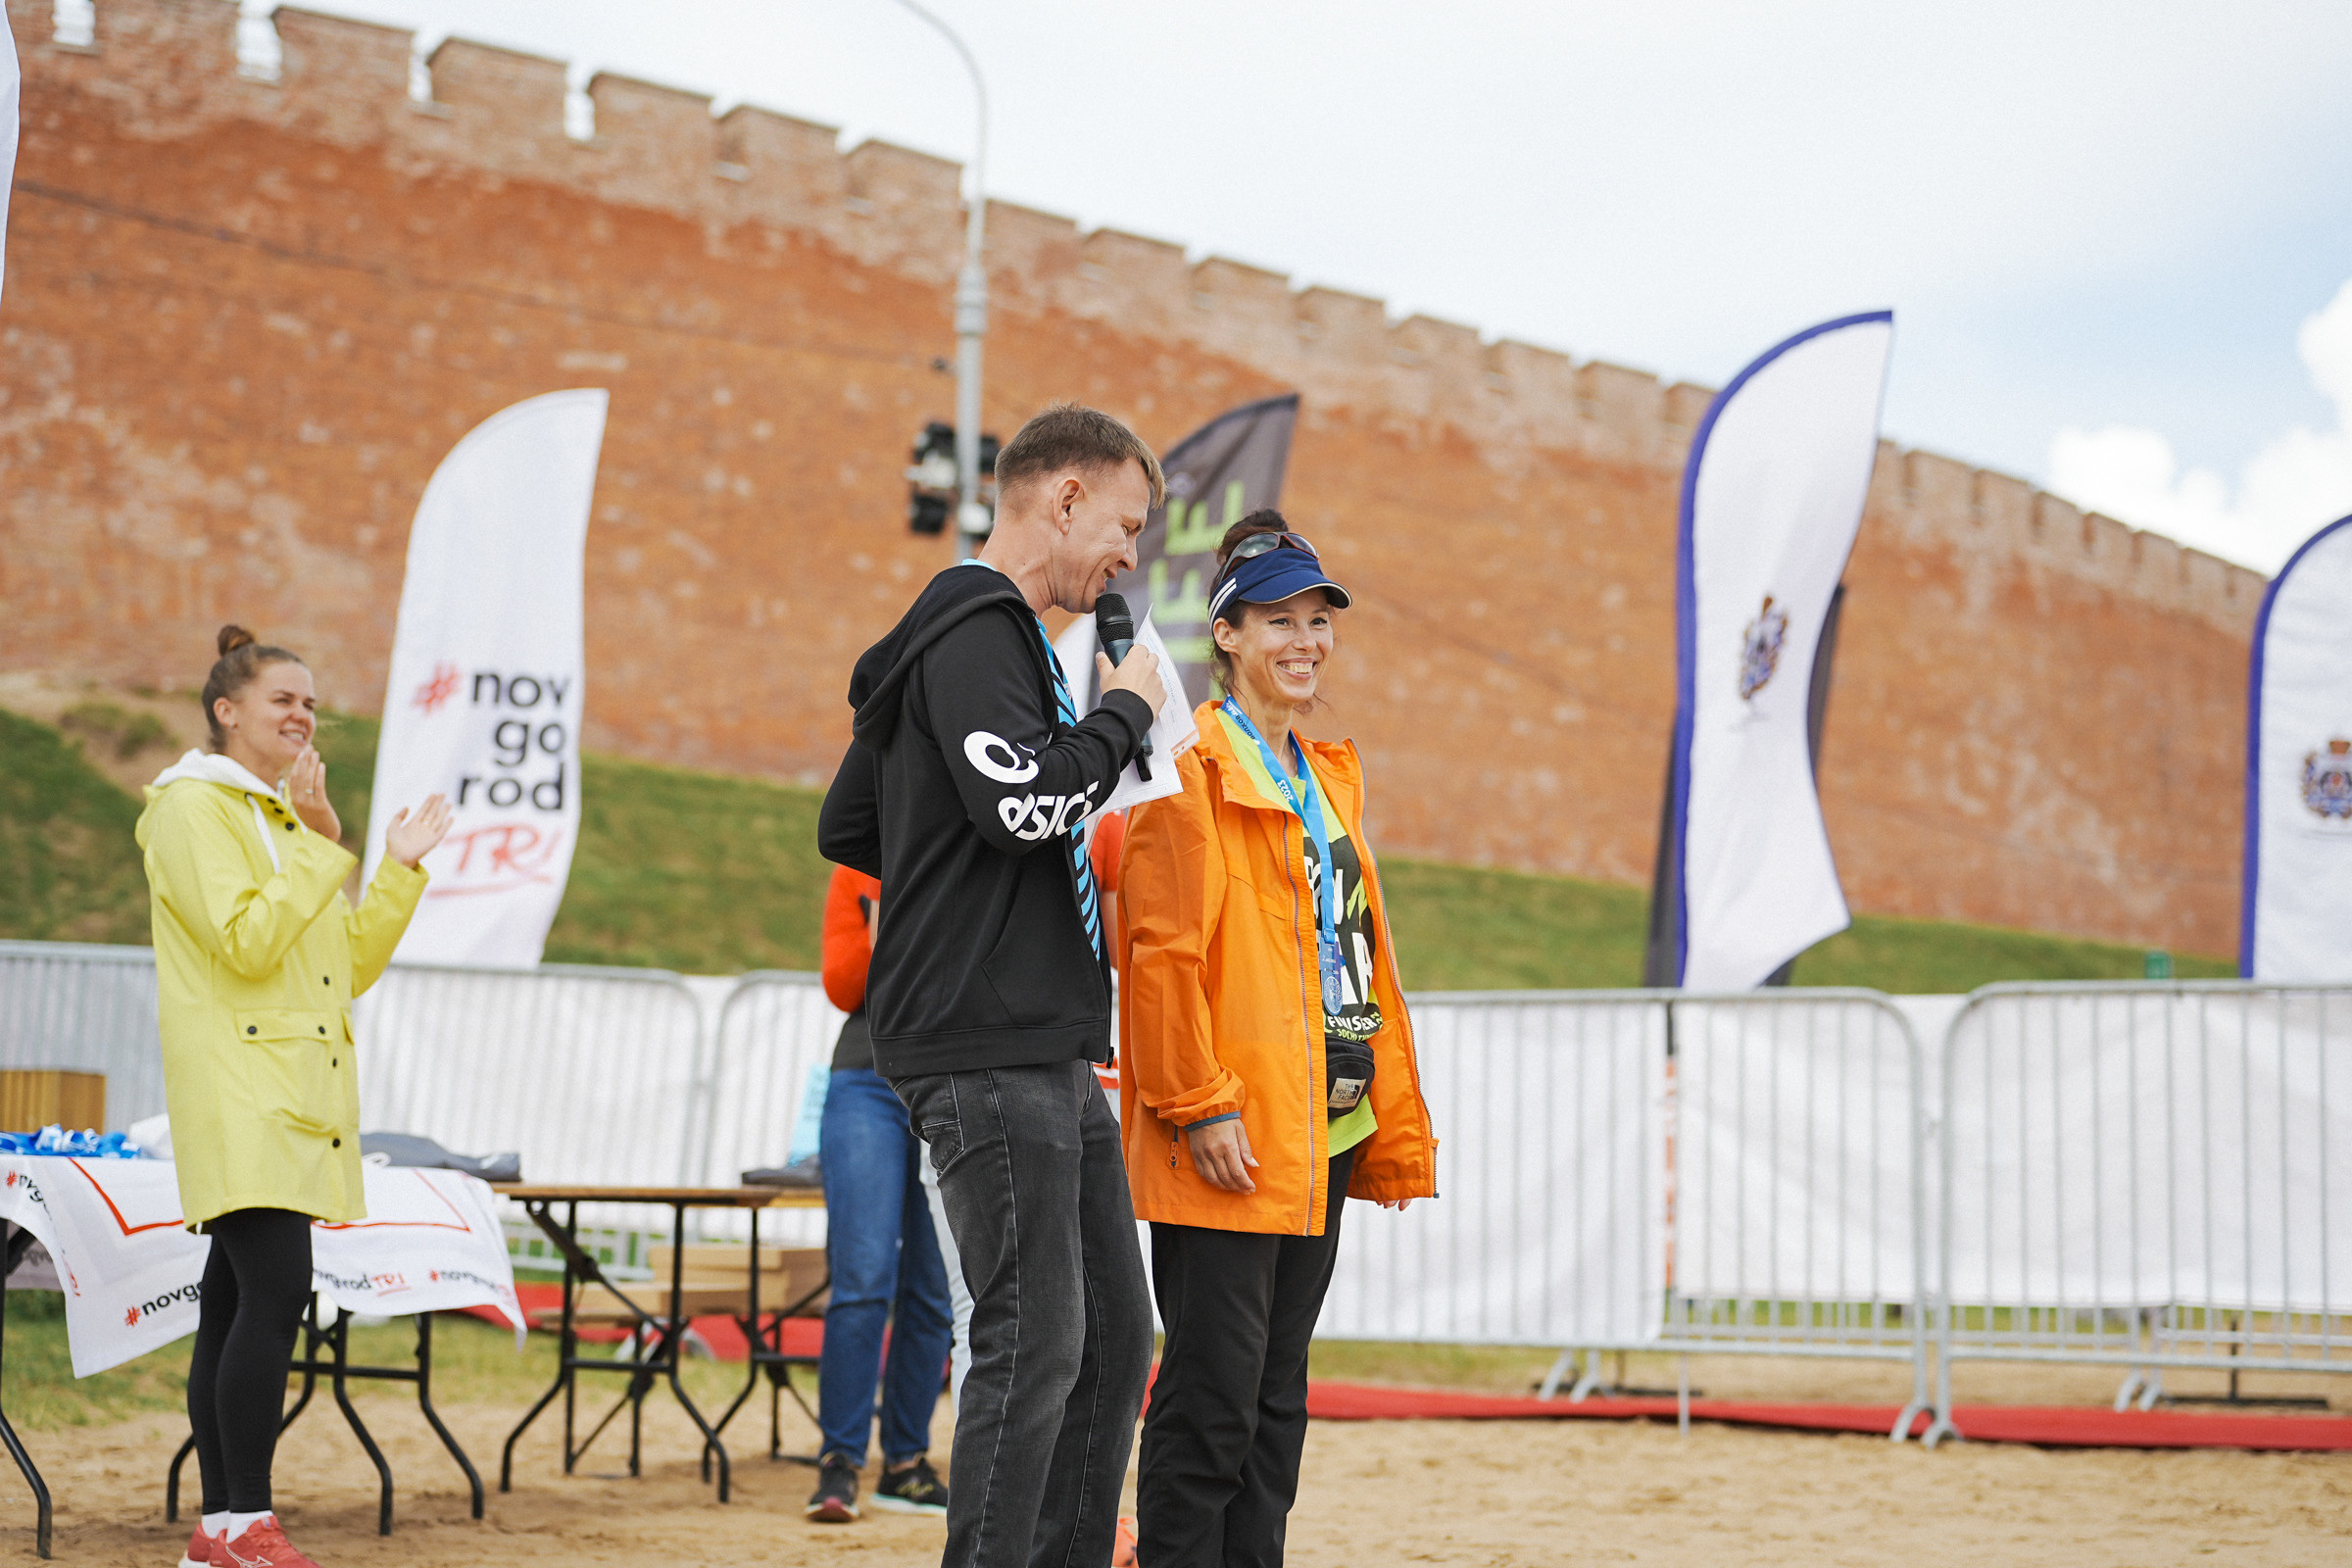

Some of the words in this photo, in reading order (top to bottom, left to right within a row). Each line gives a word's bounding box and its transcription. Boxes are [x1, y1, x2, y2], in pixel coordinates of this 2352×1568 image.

[494, 719, 565, 768] go
[458, 761, 564, 811] rod
[1277, 779, 1294, 803] 2023
